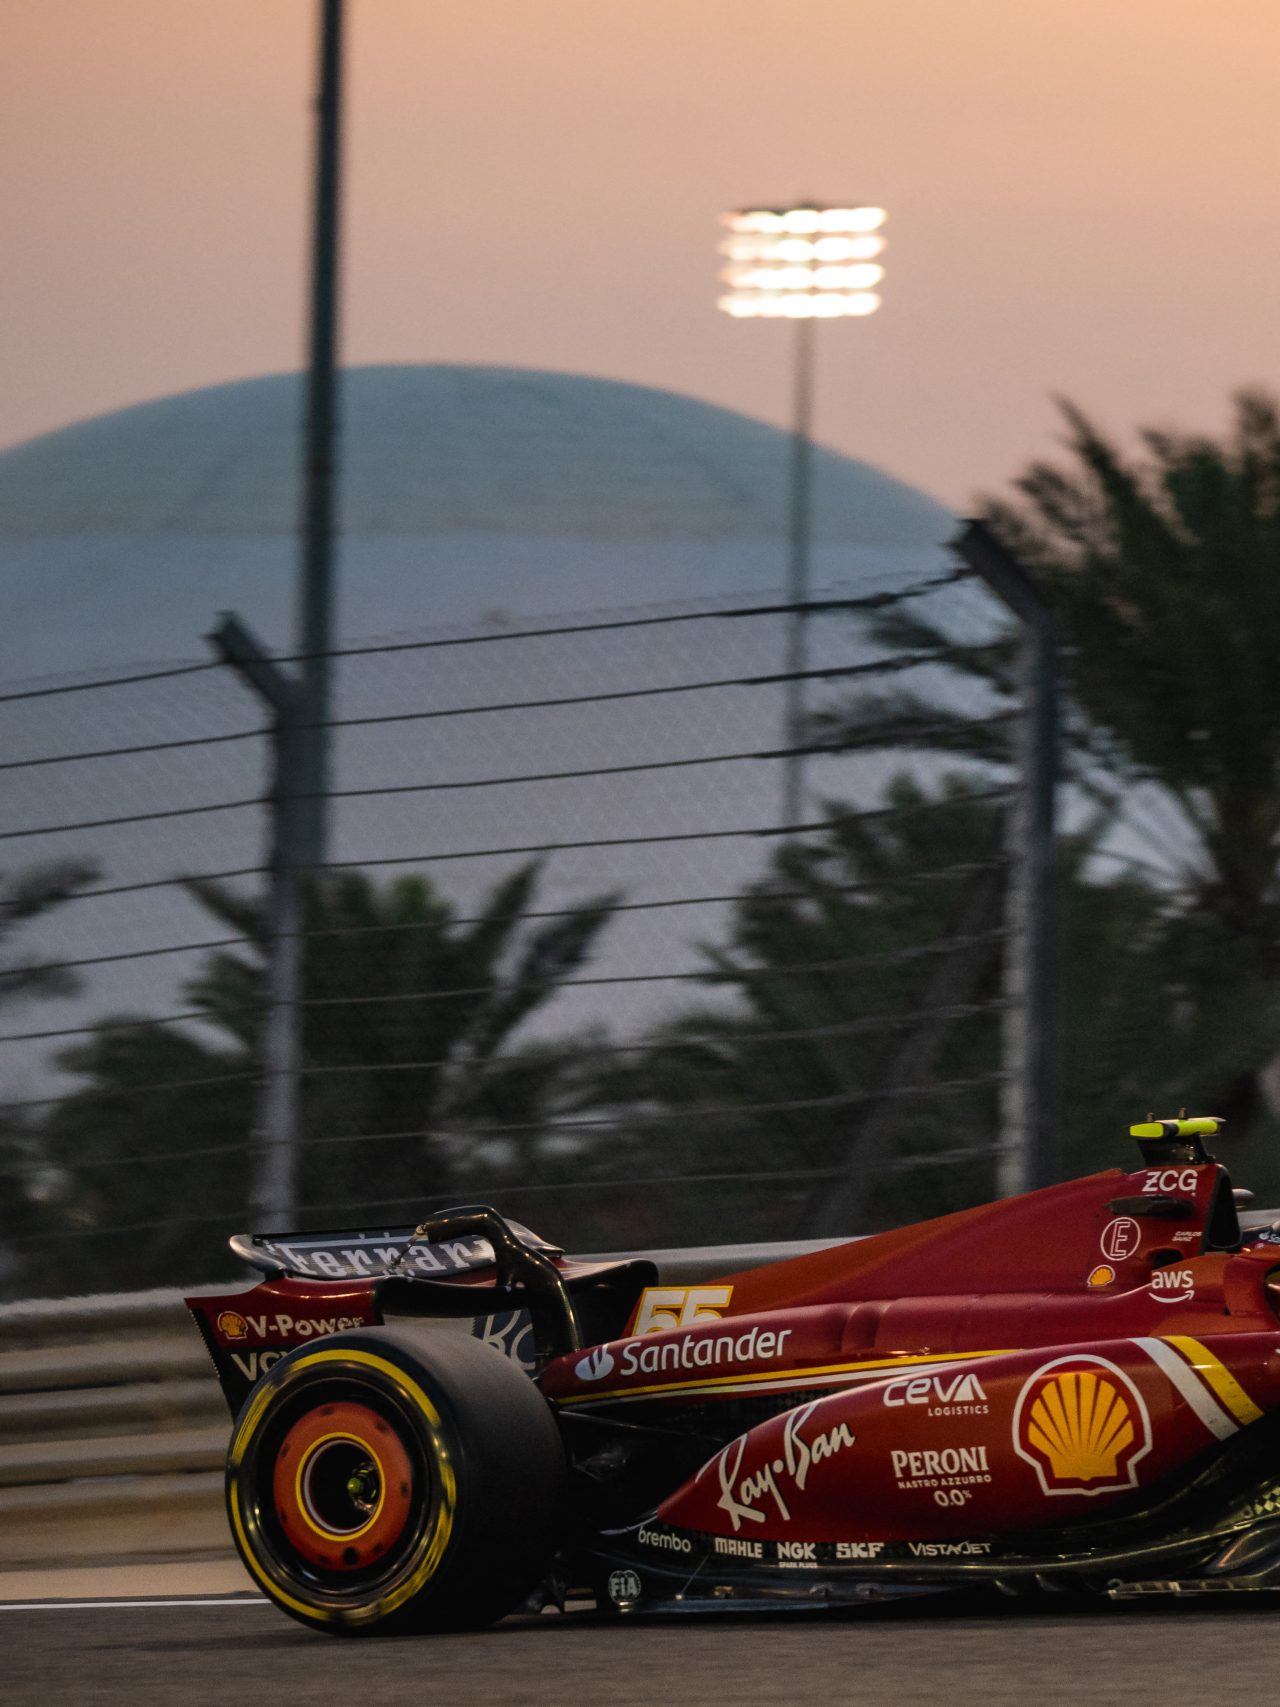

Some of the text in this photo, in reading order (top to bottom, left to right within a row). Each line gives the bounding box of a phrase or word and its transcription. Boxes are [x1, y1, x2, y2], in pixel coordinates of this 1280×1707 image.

[1141, 1168, 1199, 1192] ZCG
[1151, 1269, 1194, 1289] aws
[632, 1285, 735, 1338] 55
[246, 1314, 364, 1338] V-Power
[620, 1327, 792, 1376] Santander
[928, 1405, 989, 1416] LOGISTICS
[890, 1446, 990, 1478] PERONI
[897, 1474, 992, 1489] NASTRO AZZURRO
[638, 1525, 692, 1553] brembo
[714, 1536, 764, 1558] MAHLE
[777, 1541, 817, 1560] NGK
[836, 1542, 885, 1559] SKF
